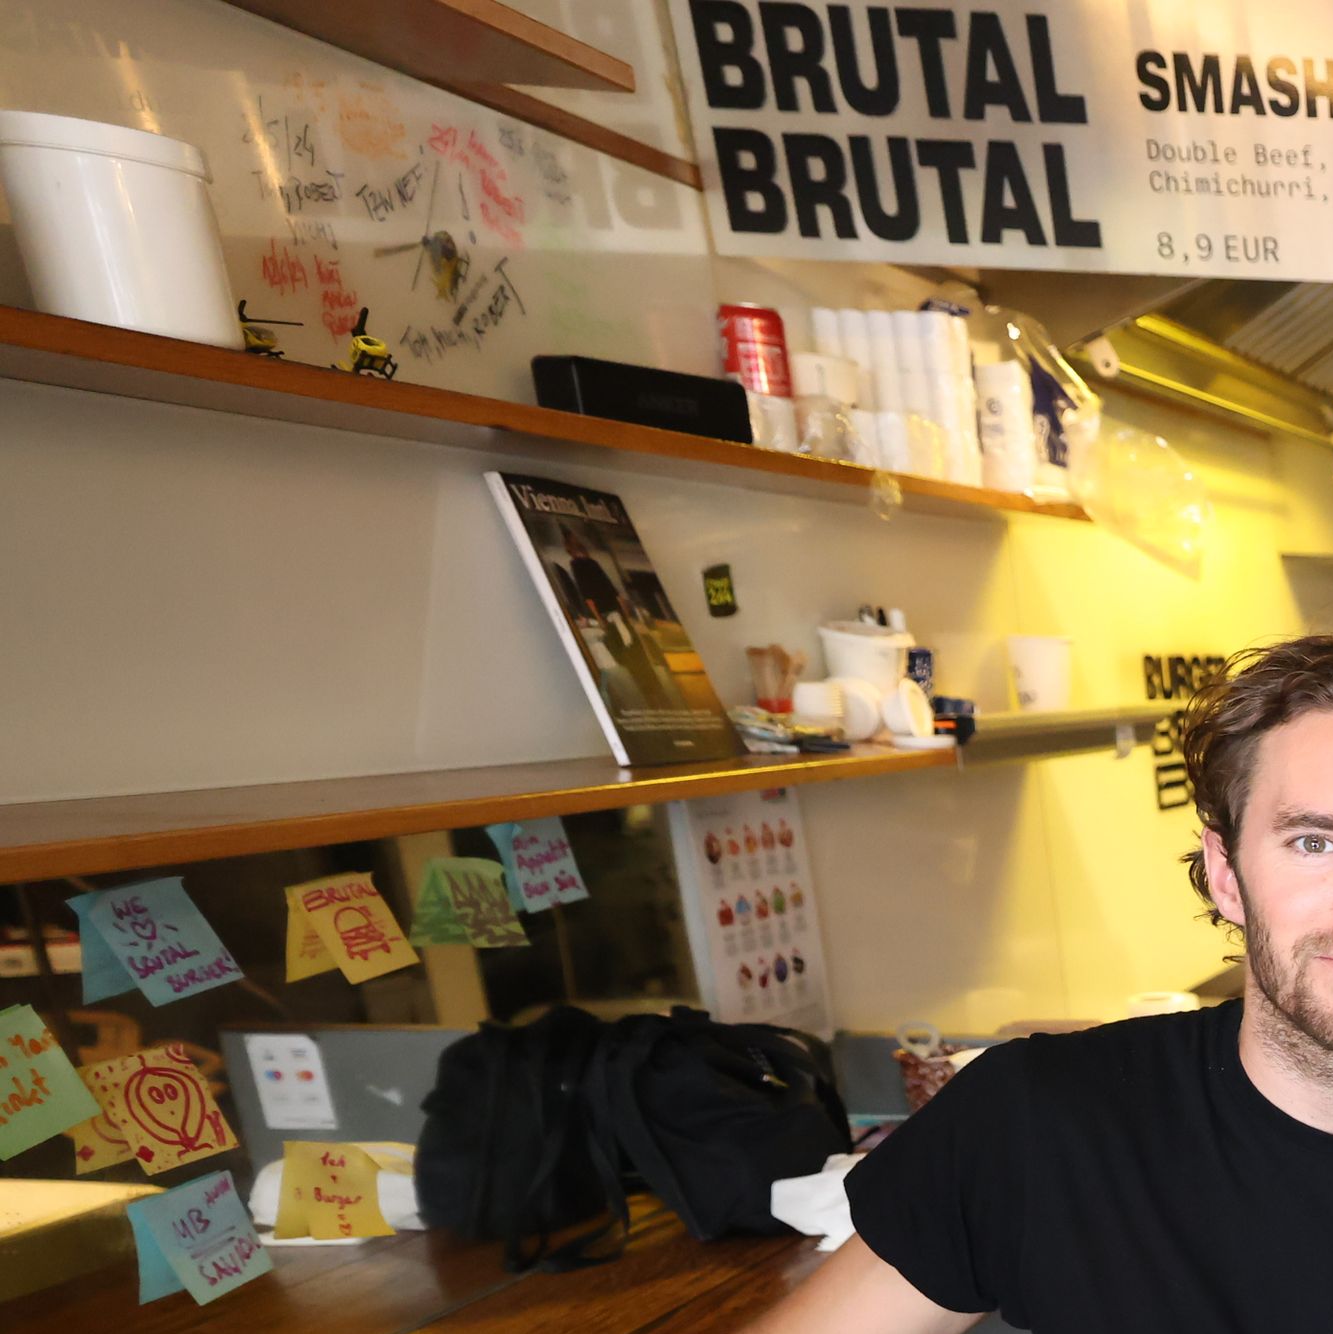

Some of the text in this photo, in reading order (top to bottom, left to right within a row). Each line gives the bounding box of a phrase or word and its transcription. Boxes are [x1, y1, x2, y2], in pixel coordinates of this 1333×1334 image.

[690, 0, 1089, 125] BRUTAL
[1146, 139, 1238, 167] Double
[1255, 143, 1328, 172] Beef,
[712, 126, 1102, 249] BRUTAL
[1149, 170, 1329, 204] Chimichurri,
[1157, 231, 1280, 266] 8,9 EUR
[302, 876, 379, 912] BRUTAL
